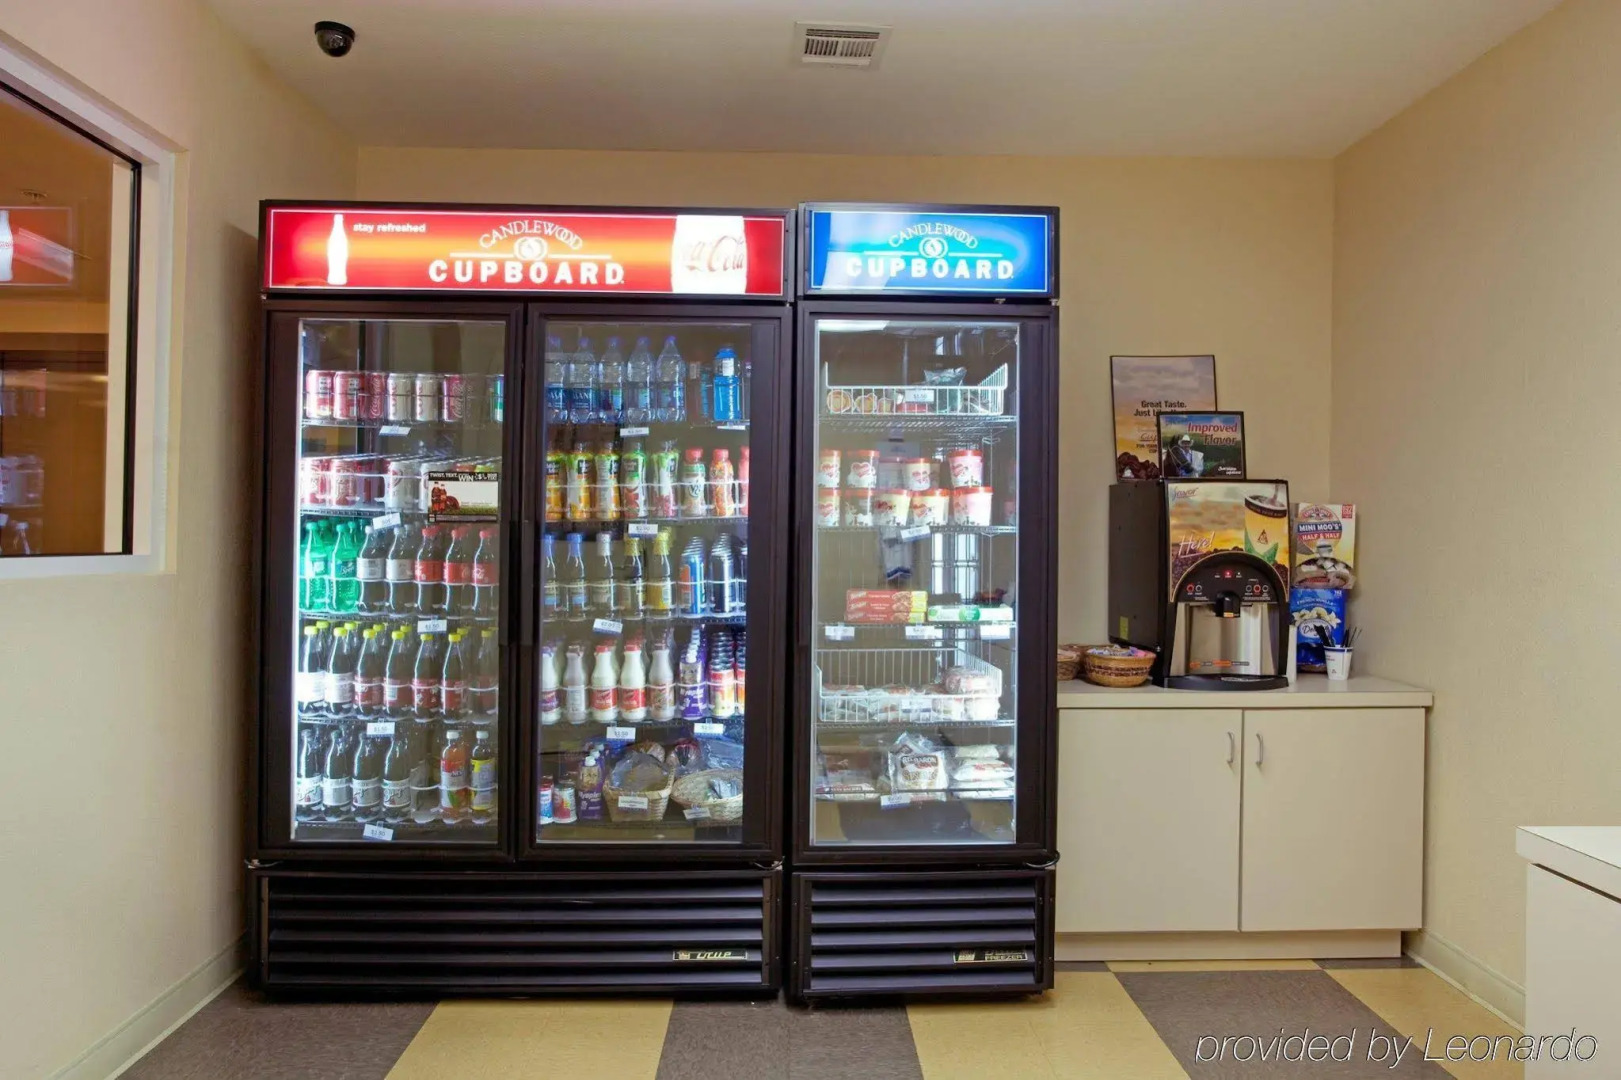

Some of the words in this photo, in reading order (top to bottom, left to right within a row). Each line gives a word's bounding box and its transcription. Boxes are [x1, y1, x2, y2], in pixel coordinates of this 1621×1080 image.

[353, 223, 374, 233] stay
[376, 221, 427, 232] refreshed
[479, 219, 583, 250] CANDLEWOOD
[888, 222, 979, 249] CANDLEWOOD
[428, 259, 624, 285] CUPBOARD
[846, 258, 1014, 280] CUPBOARD
[1141, 400, 1162, 409] Great
[1164, 400, 1187, 408] Taste.
[1134, 409, 1151, 417] Just
[1187, 422, 1238, 434] Improved
[1204, 434, 1237, 446] Flavor
[1317, 523, 1339, 531] MOO'S
[1178, 531, 1215, 556] Here!
